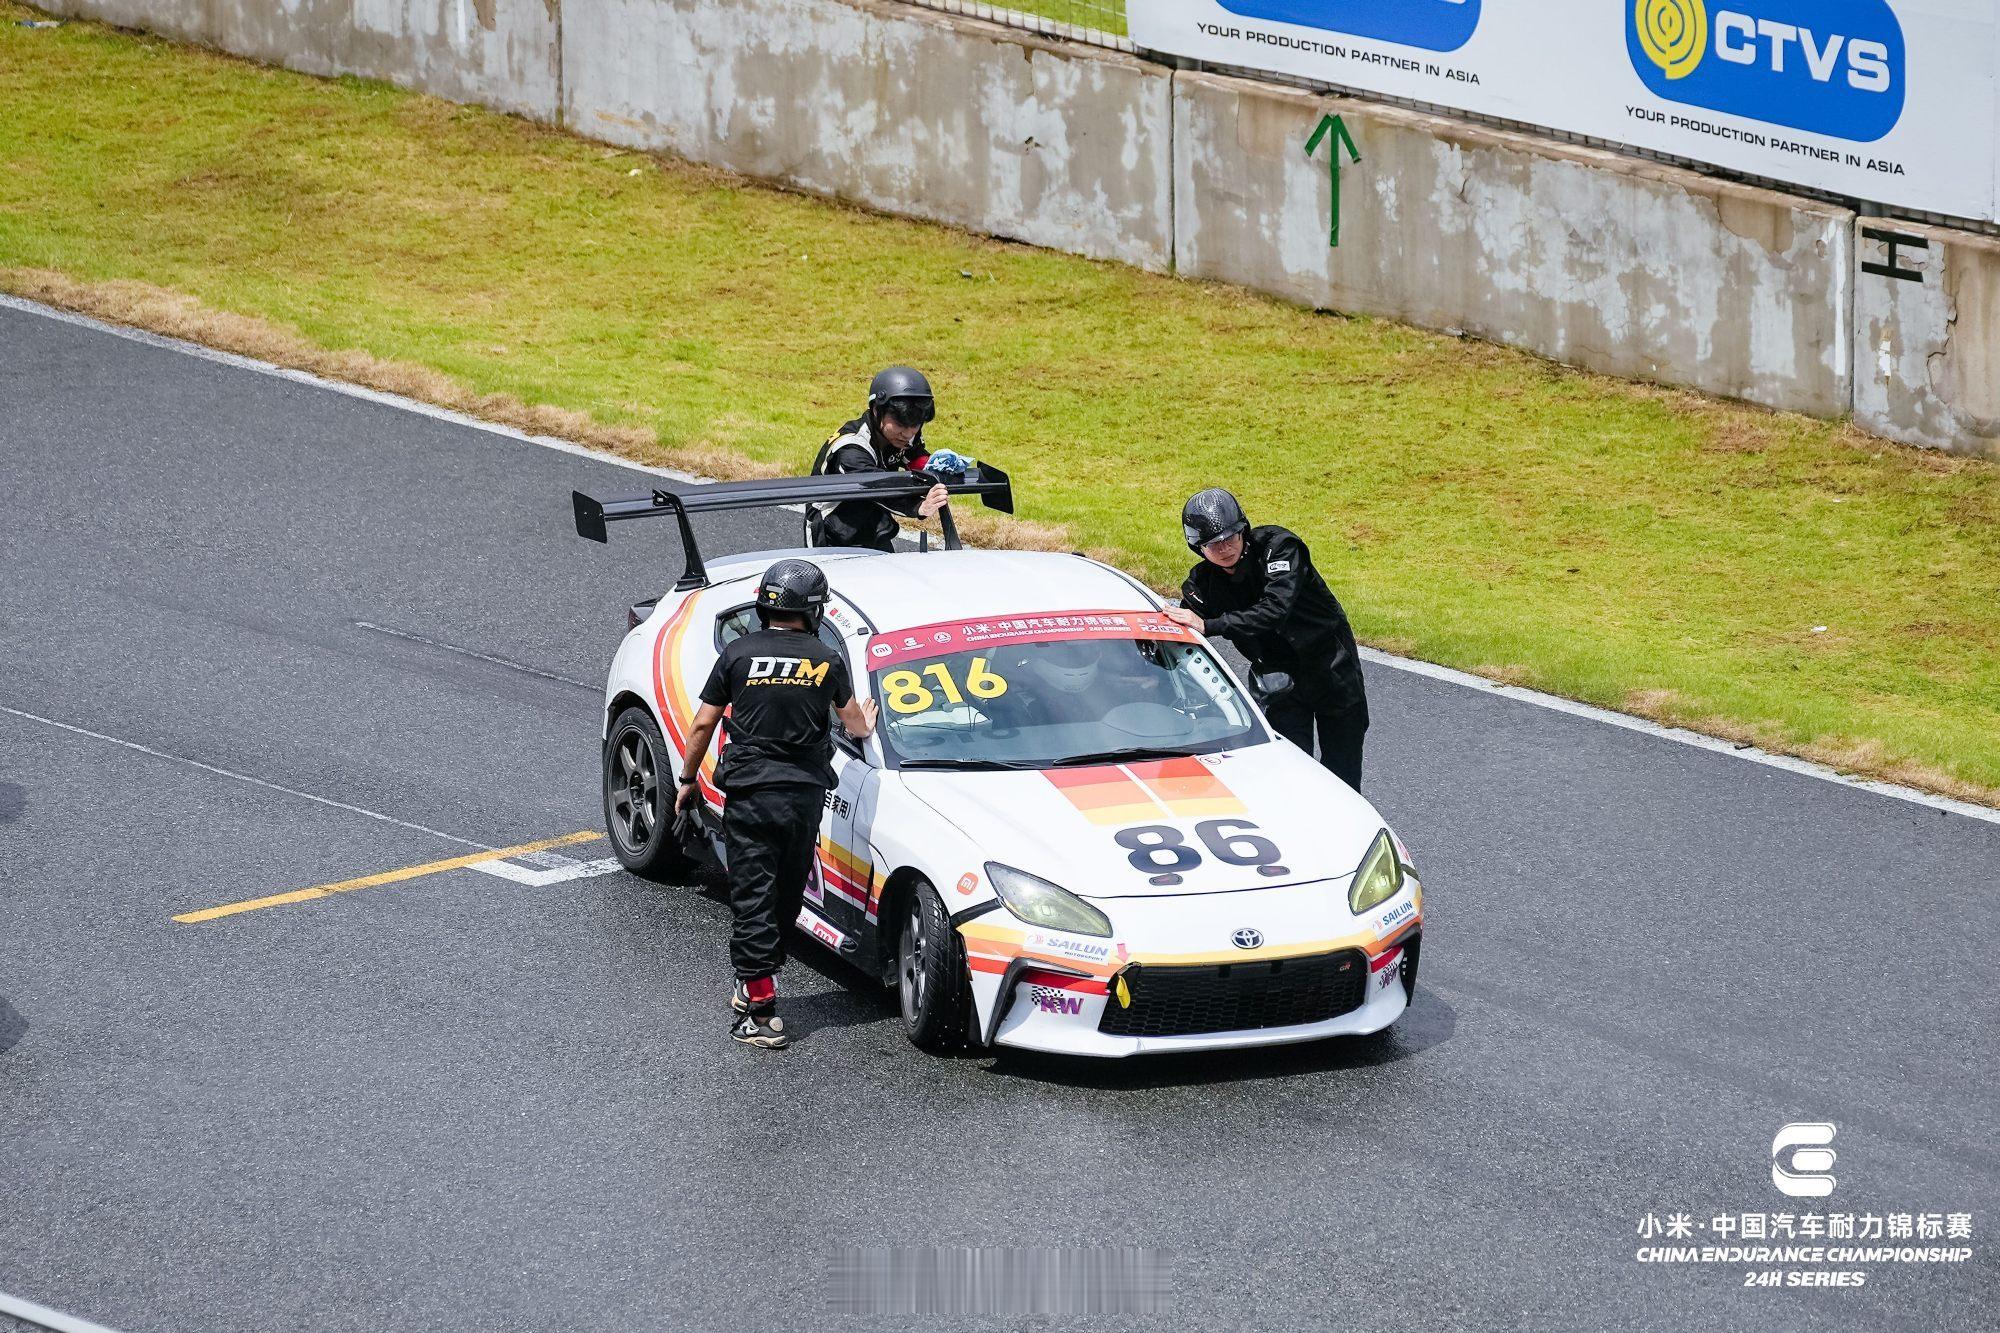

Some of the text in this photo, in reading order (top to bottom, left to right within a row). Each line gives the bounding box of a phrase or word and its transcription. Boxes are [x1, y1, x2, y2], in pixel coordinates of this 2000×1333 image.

[1197, 22, 1480, 85] YOUR PRODUCTION PARTNER IN ASIA
[1714, 9, 1891, 93] CTVS
[1625, 105, 1905, 176] YOUR PRODUCTION PARTNER IN ASIA
[745, 677, 814, 687] RACING
[747, 656, 830, 687] DTM
[882, 657, 1008, 714] 816
[1114, 819, 1281, 874] 86
[1382, 900, 1413, 926] SAILUN
[1047, 938, 1109, 956] SAILUN
[1040, 995, 1084, 1015] KW
